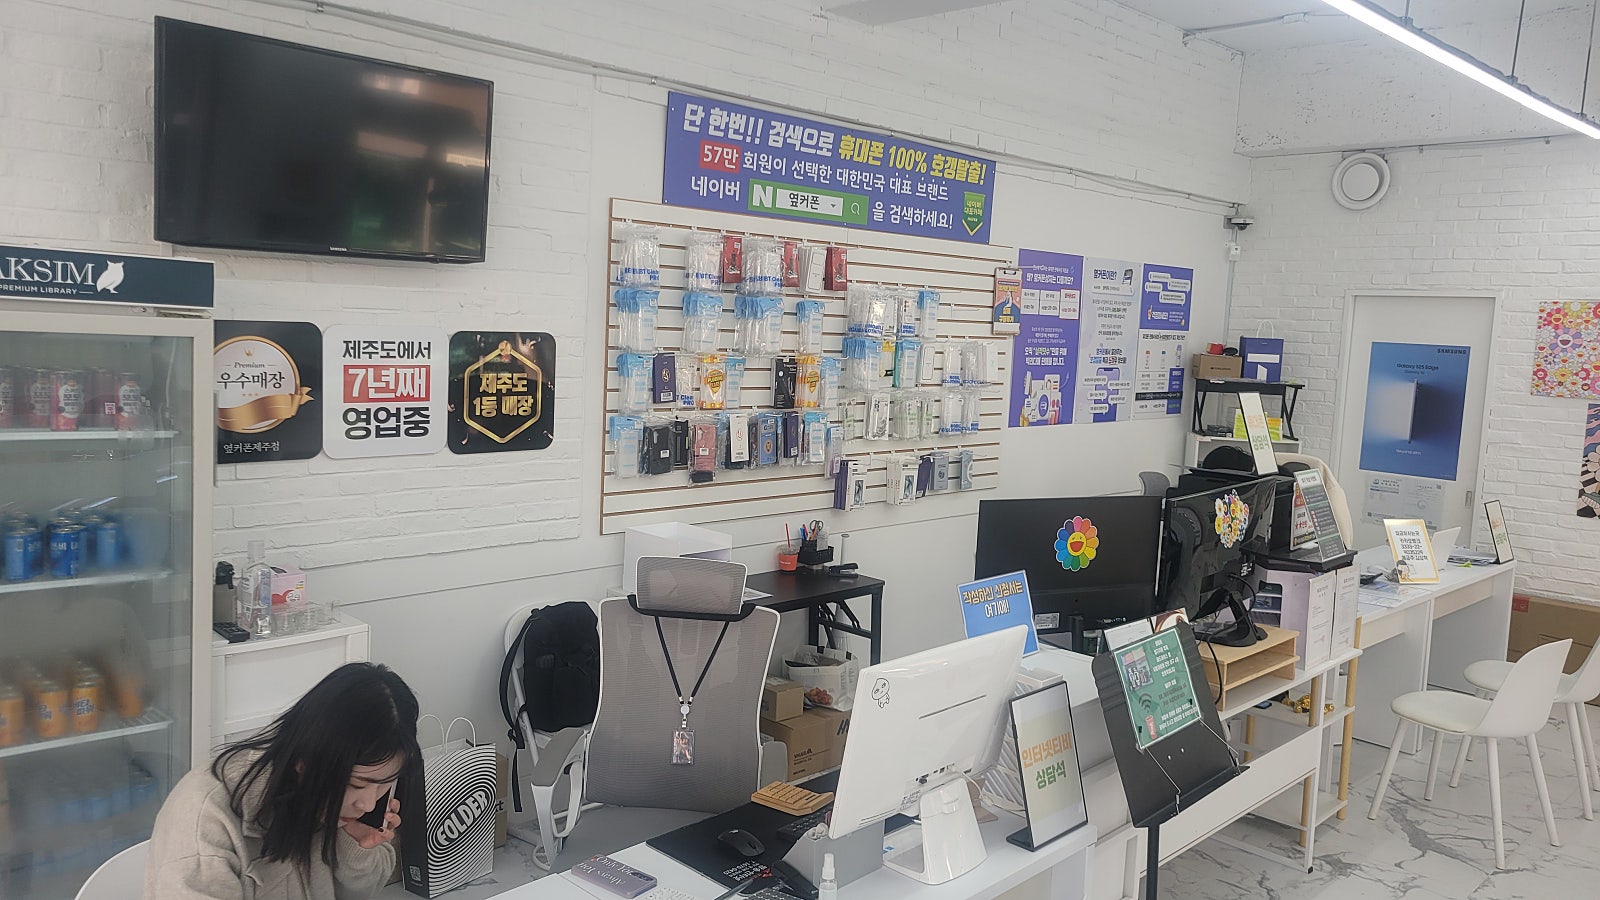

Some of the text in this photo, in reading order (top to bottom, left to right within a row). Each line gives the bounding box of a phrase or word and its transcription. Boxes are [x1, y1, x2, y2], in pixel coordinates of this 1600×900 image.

[684, 103, 987, 186] 단 한번!! 검색으로 휴대폰 100% 호갱탈출!
[703, 144, 949, 201] 57만 회원이 선택한 대한민국 대표 브랜드
[691, 176, 953, 229] 네이버 N 옆커폰 을 검색하세요!
[40, 287, 77, 295] LIBRARY
[342, 340, 431, 360] 제주도에서
[217, 371, 286, 390] 우수매장
[348, 367, 427, 399] 7년째
[479, 373, 528, 394] 제주도
[472, 395, 534, 418] 1등 매장
[342, 406, 431, 440] 영업중
[223, 440, 280, 454] 옆커폰제주점
[962, 580, 1023, 604] 작성하신 신청서는
[1036, 760, 1067, 789] 상담석
[436, 790, 488, 846] FOLDER
